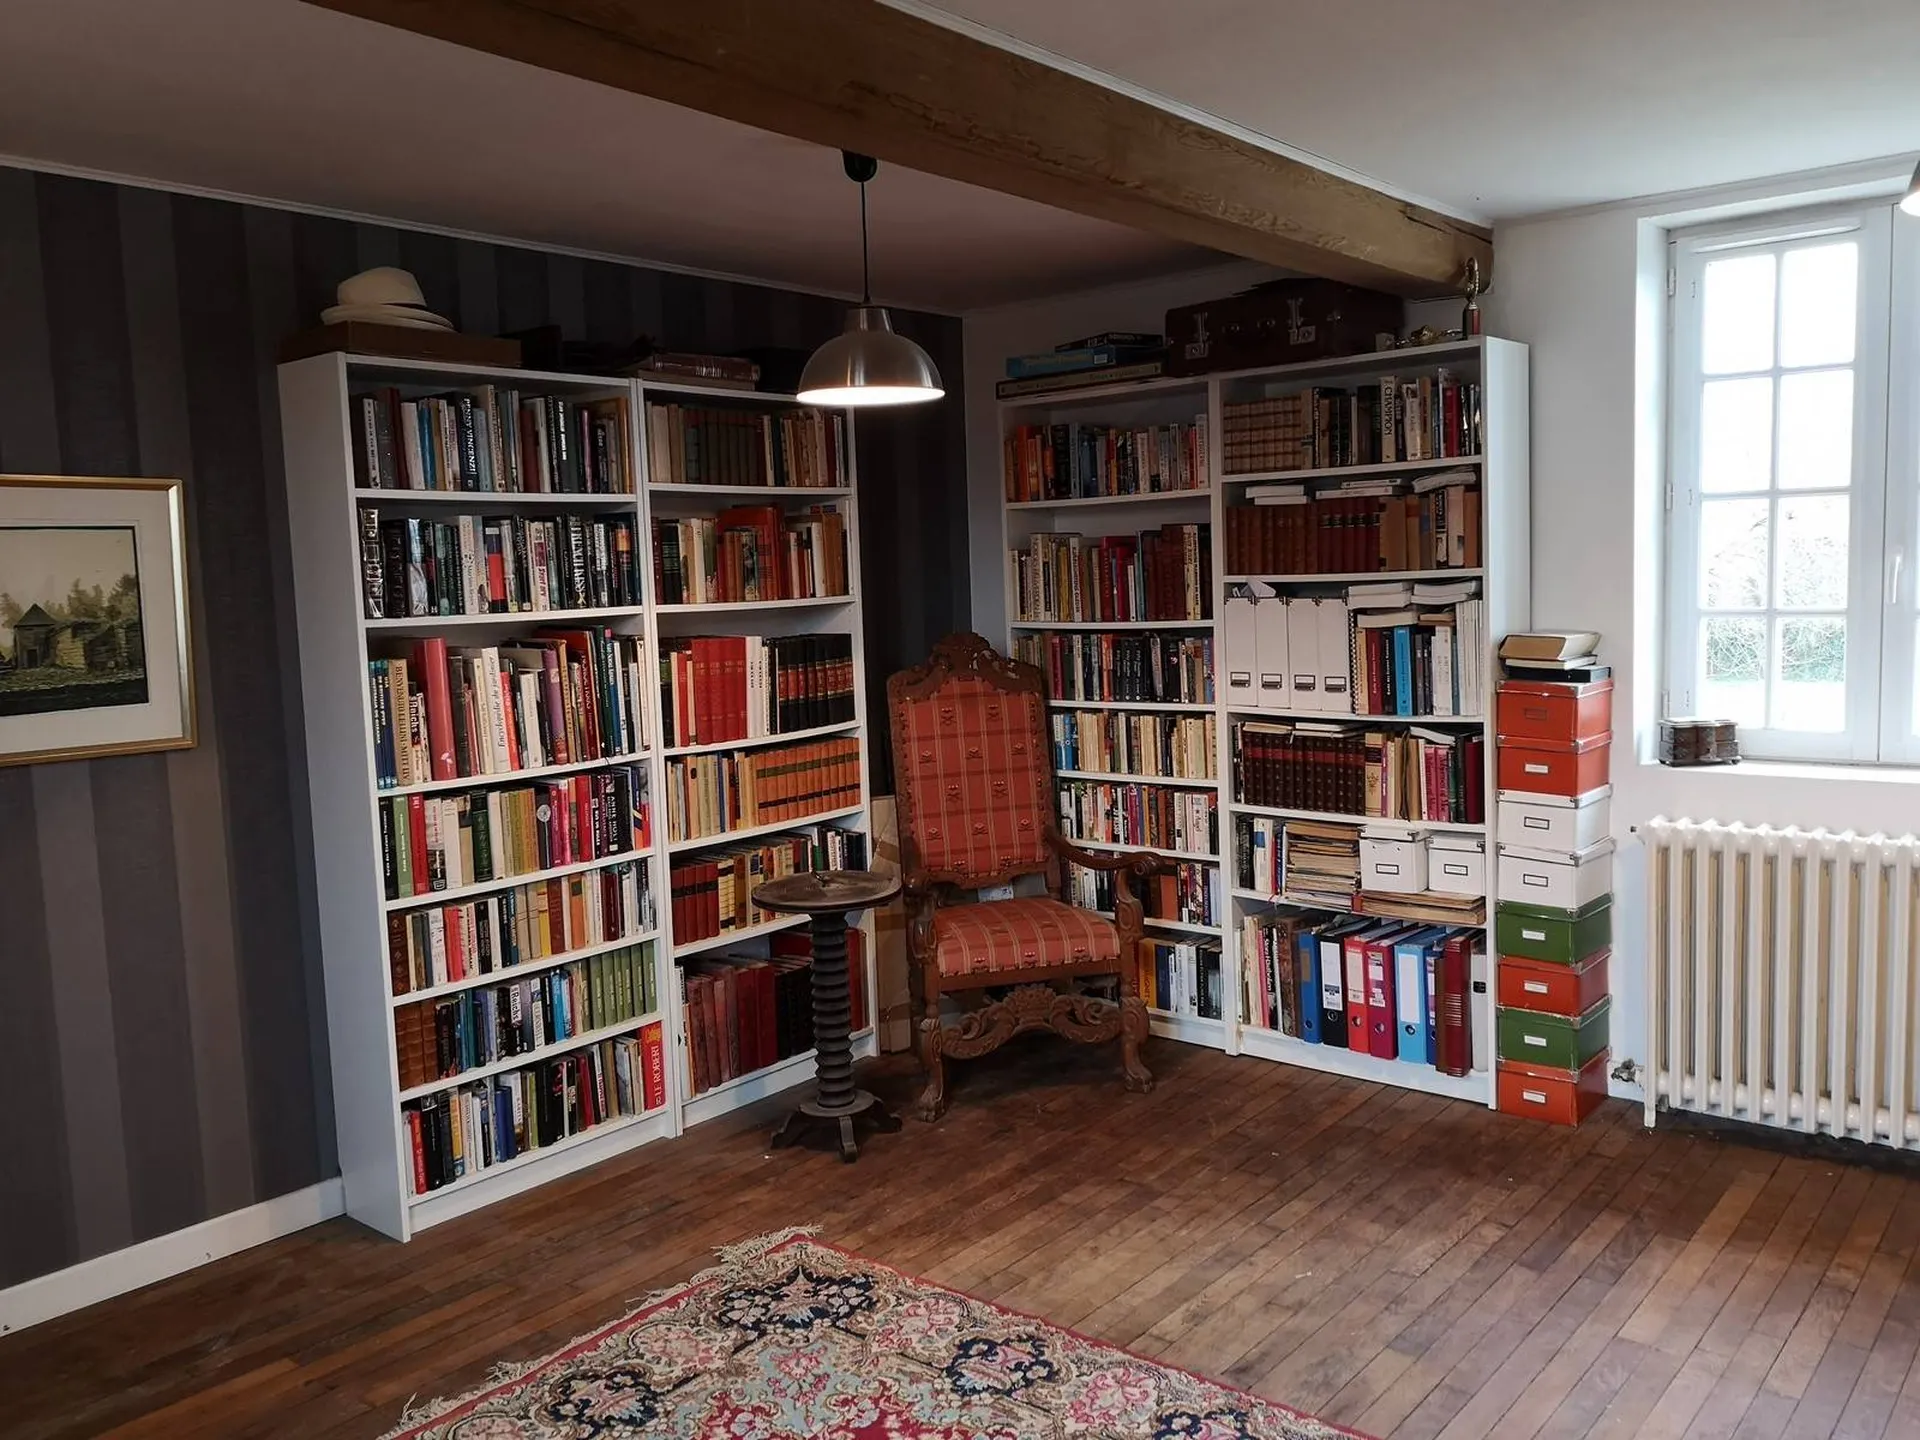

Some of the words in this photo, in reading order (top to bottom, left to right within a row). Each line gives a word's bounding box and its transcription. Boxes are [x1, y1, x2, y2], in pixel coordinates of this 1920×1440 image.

[464, 398, 473, 428] PENNY
[1384, 386, 1393, 436] CHAMPION
[466, 430, 477, 472] VINCENZI
[571, 527, 585, 566] FRENCH
[574, 568, 586, 593] KISS
[395, 666, 405, 711] BENVENUTO
[651, 1045, 661, 1083] ROBERT
[654, 1084, 662, 1096] LE
